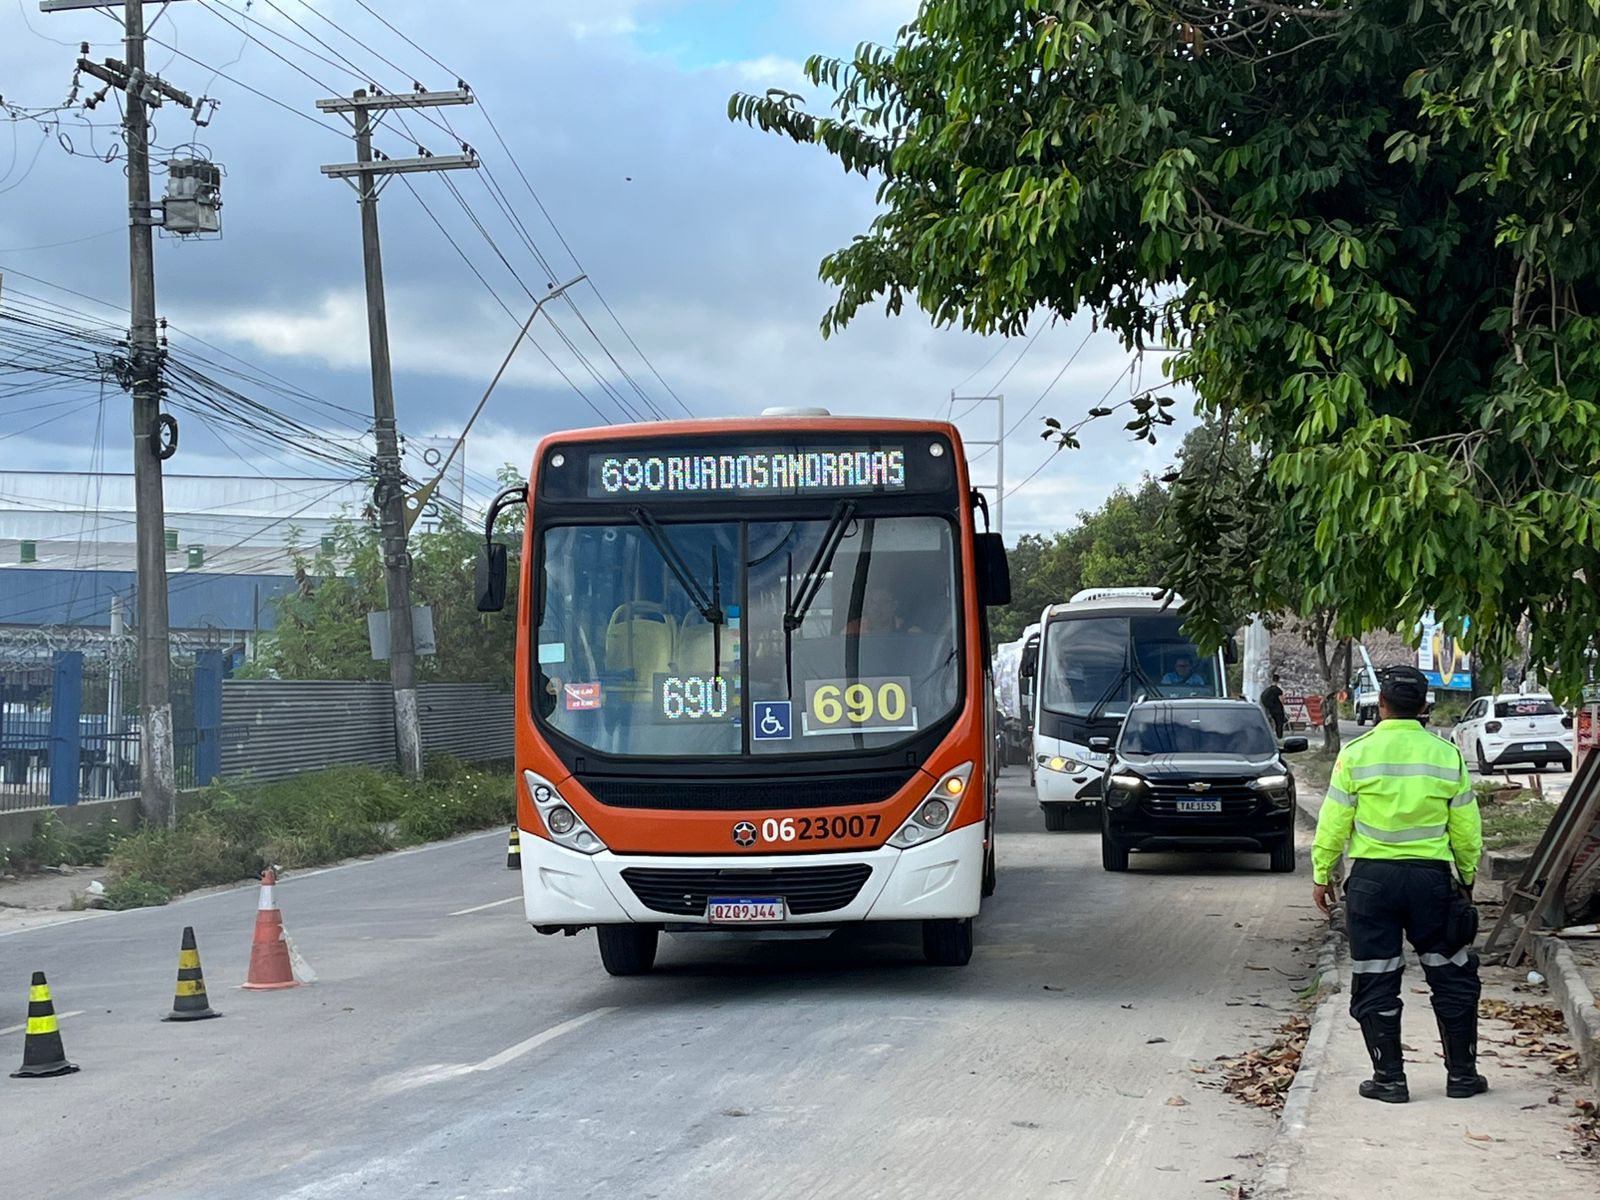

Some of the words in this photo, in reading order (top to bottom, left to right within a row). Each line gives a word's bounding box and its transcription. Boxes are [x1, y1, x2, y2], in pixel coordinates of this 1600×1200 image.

[602, 457, 665, 492] 690
[668, 455, 717, 491] RUA
[720, 454, 769, 489] DOS
[772, 450, 905, 488] ANDRADAS
[663, 676, 728, 719] 690
[813, 682, 906, 724] 690
